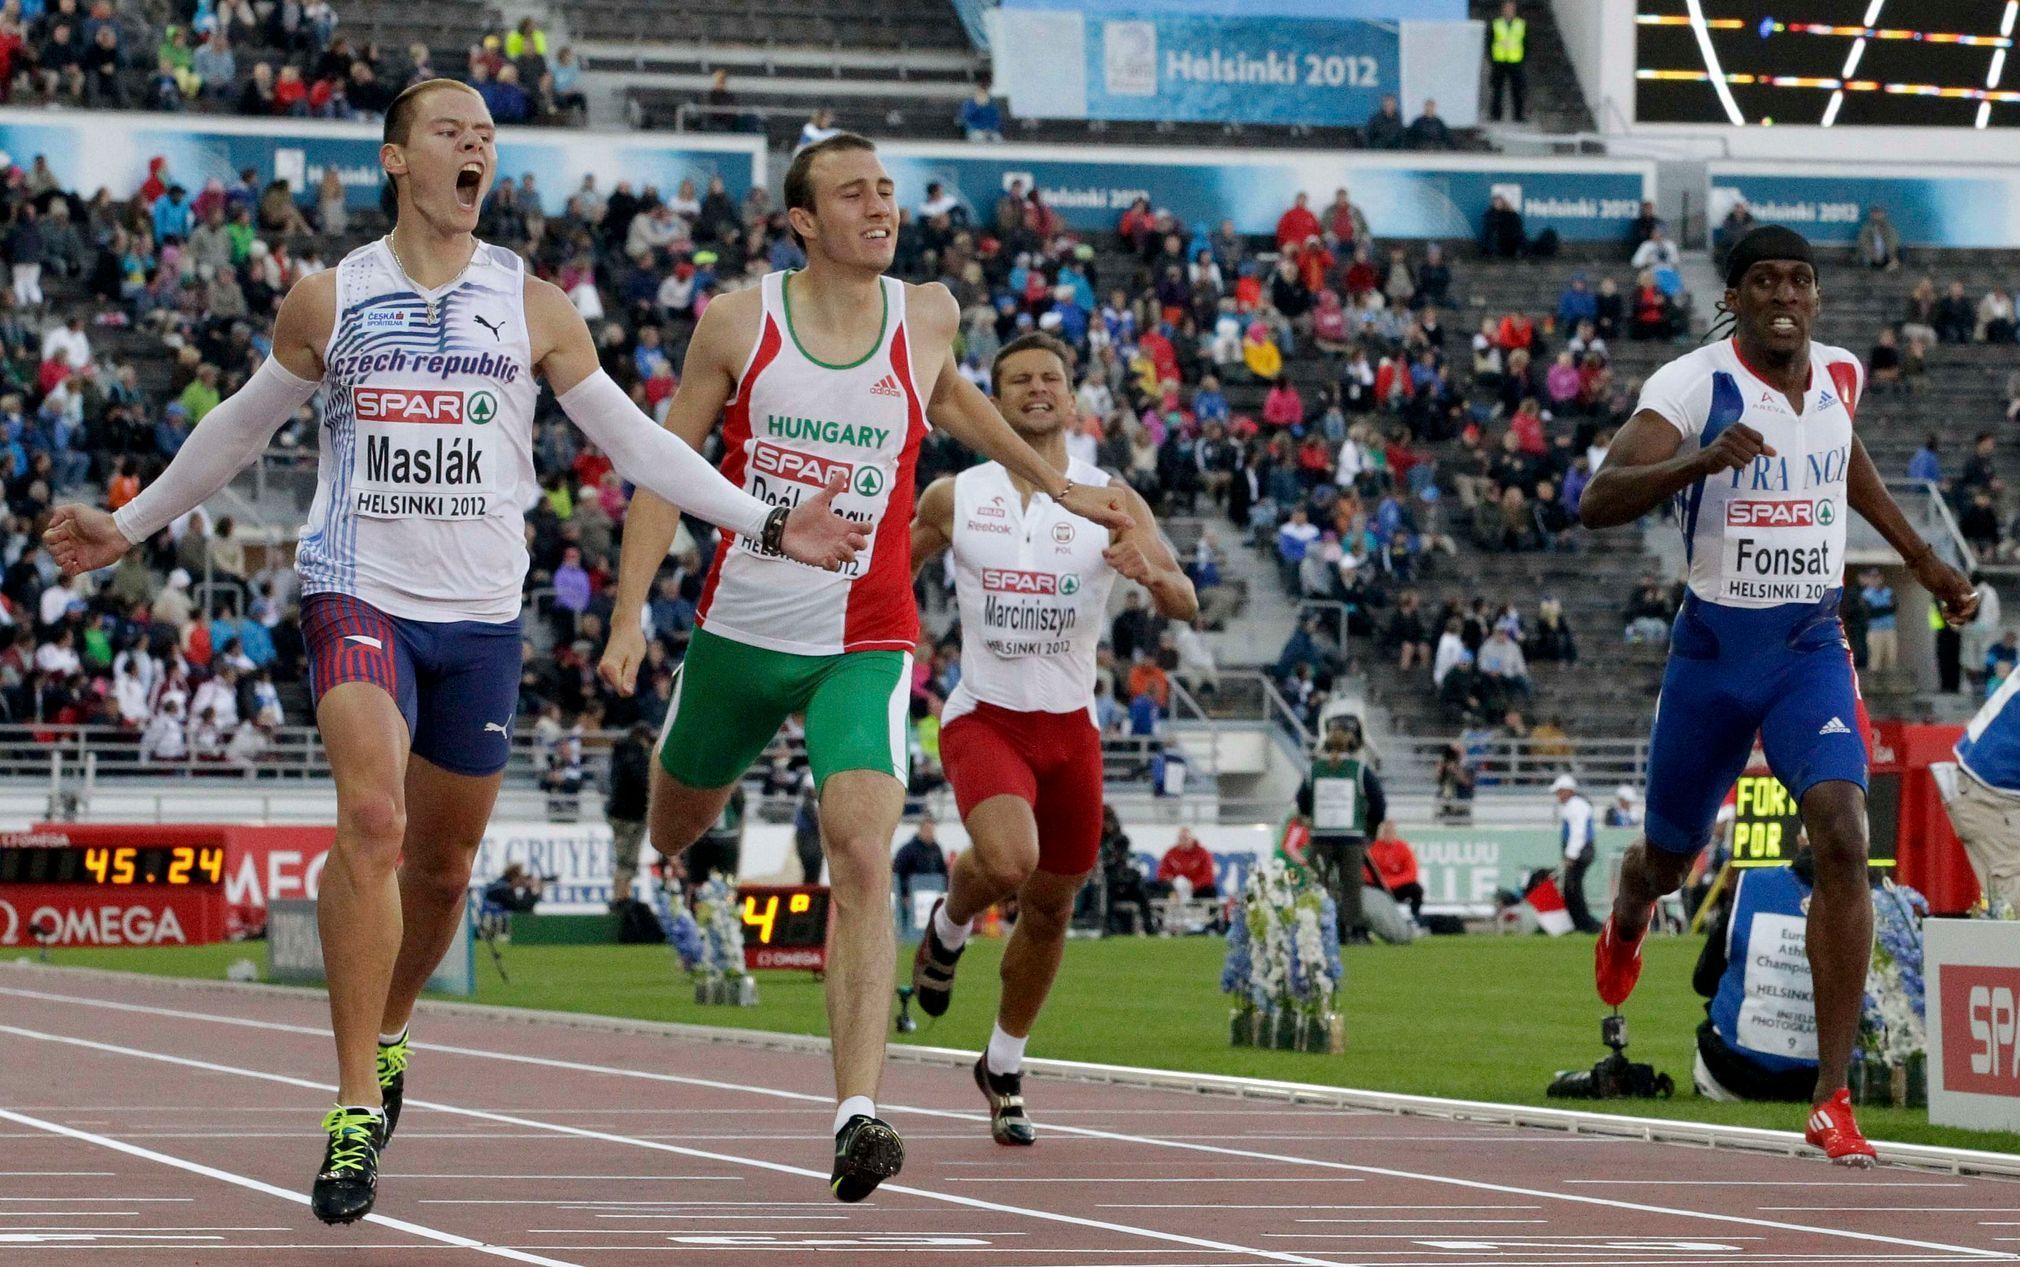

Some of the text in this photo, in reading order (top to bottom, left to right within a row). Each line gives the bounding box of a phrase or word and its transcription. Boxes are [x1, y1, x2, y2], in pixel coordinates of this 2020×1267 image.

[1165, 48, 1296, 85] Helsinki
[1304, 55, 1379, 87] 2012
[1525, 197, 1598, 218] Helsinki
[1820, 203, 1860, 222] 2012
[870, 387, 901, 398] adidas
[356, 392, 460, 419] SPAR
[1753, 403, 1786, 415] AREVA
[767, 415, 890, 450] HUNGARY
[367, 435, 482, 485] Maslák
[755, 446, 850, 489] SPAR
[357, 493, 486, 516] HELSINKI 2012
[1729, 503, 1812, 523] SPAR
[967, 520, 1013, 535] Reebok
[1056, 547, 1072, 555] POL
[1736, 539, 1830, 576] Fonsat
[984, 570, 1055, 593] SPAR
[1729, 581, 1827, 599] HELSINKI 20
[985, 595, 1075, 637] Marciniszyn
[1046, 640, 1071, 655] 2012
[1819, 727, 1851, 735] adidas
[1733, 822, 1782, 857] POR
[85, 847, 223, 884] 45.24
[30, 905, 187, 944] OMEGA
[1781, 928, 1806, 941] Euro
[1779, 945, 1806, 957] Ath
[1756, 956, 1811, 974] Champio
[1970, 985, 2020, 1078] SP
[1788, 1037, 1797, 1049] 9
